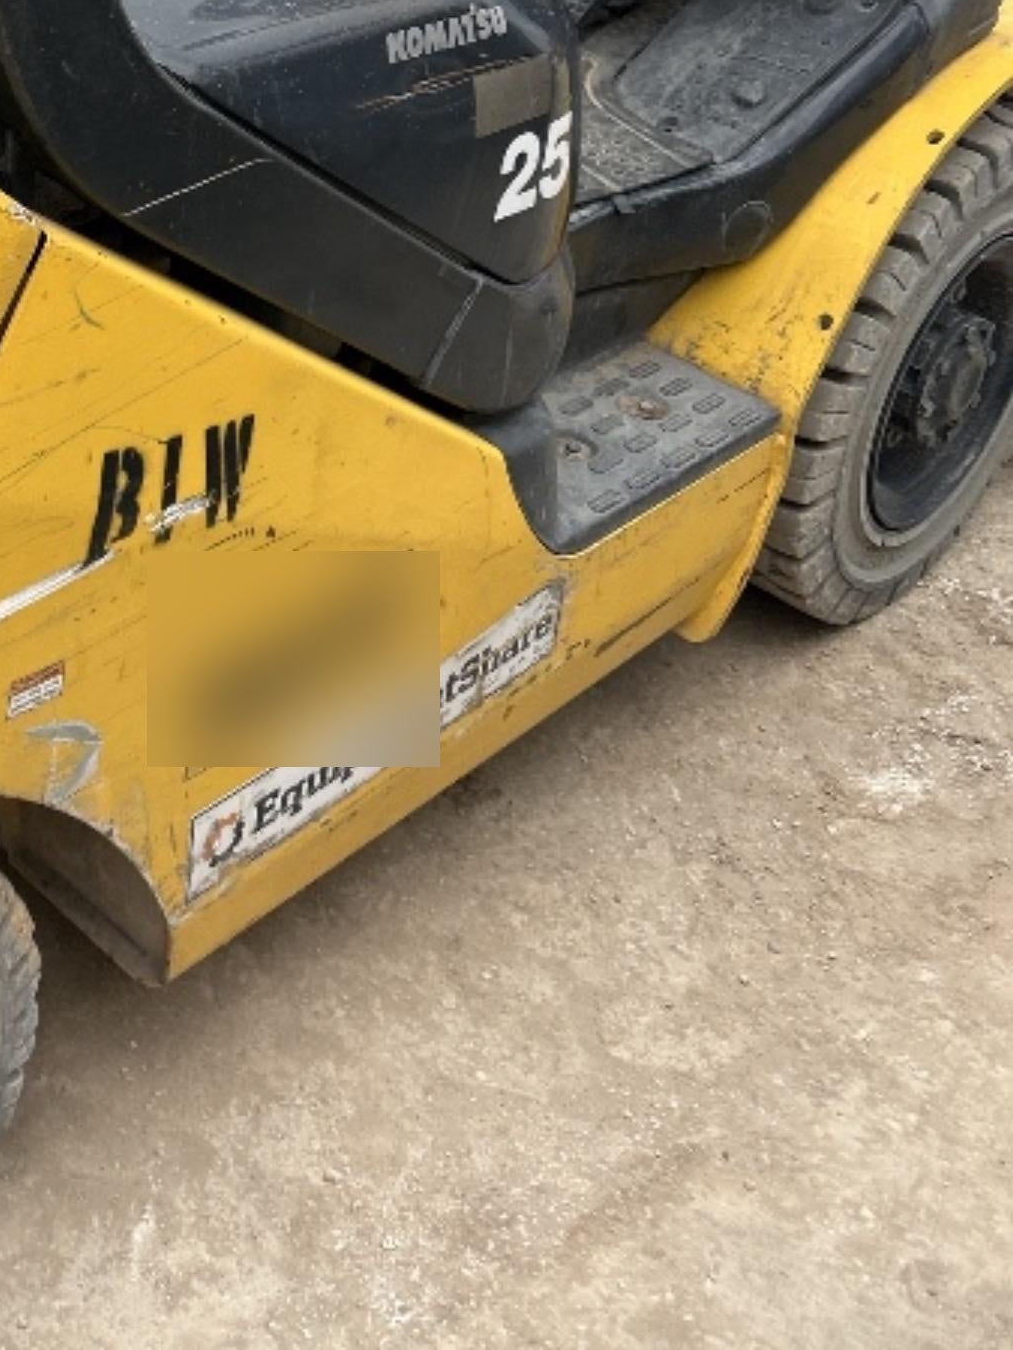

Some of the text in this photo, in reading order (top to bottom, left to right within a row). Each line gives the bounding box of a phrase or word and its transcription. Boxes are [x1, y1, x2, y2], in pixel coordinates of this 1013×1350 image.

[385, 3, 508, 64] KOMATSU
[493, 111, 573, 223] 25
[83, 413, 255, 569] BIW
